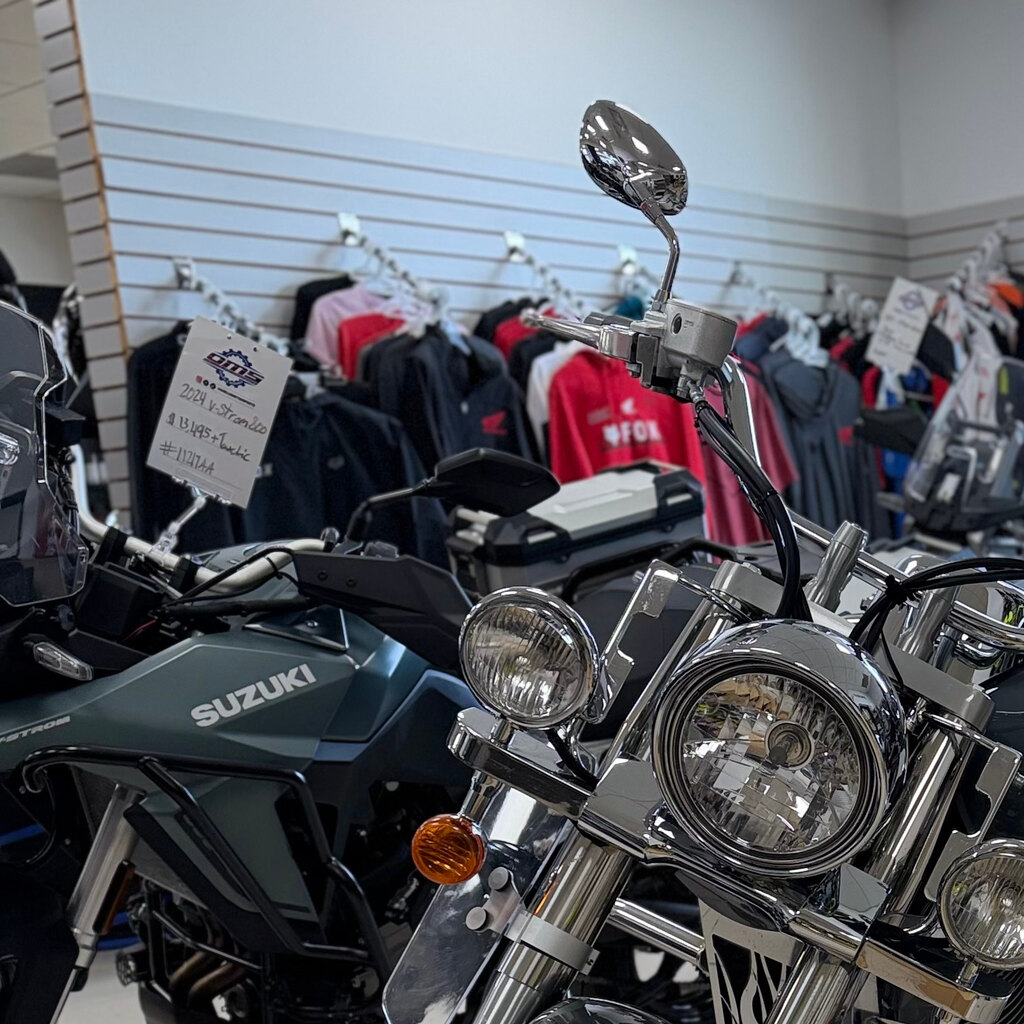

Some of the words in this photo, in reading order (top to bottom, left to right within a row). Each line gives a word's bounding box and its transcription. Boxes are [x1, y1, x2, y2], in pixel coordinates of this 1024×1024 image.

[179, 383, 207, 405] 2024
[621, 420, 662, 443] FOX
[190, 663, 318, 728] SUZUKI
